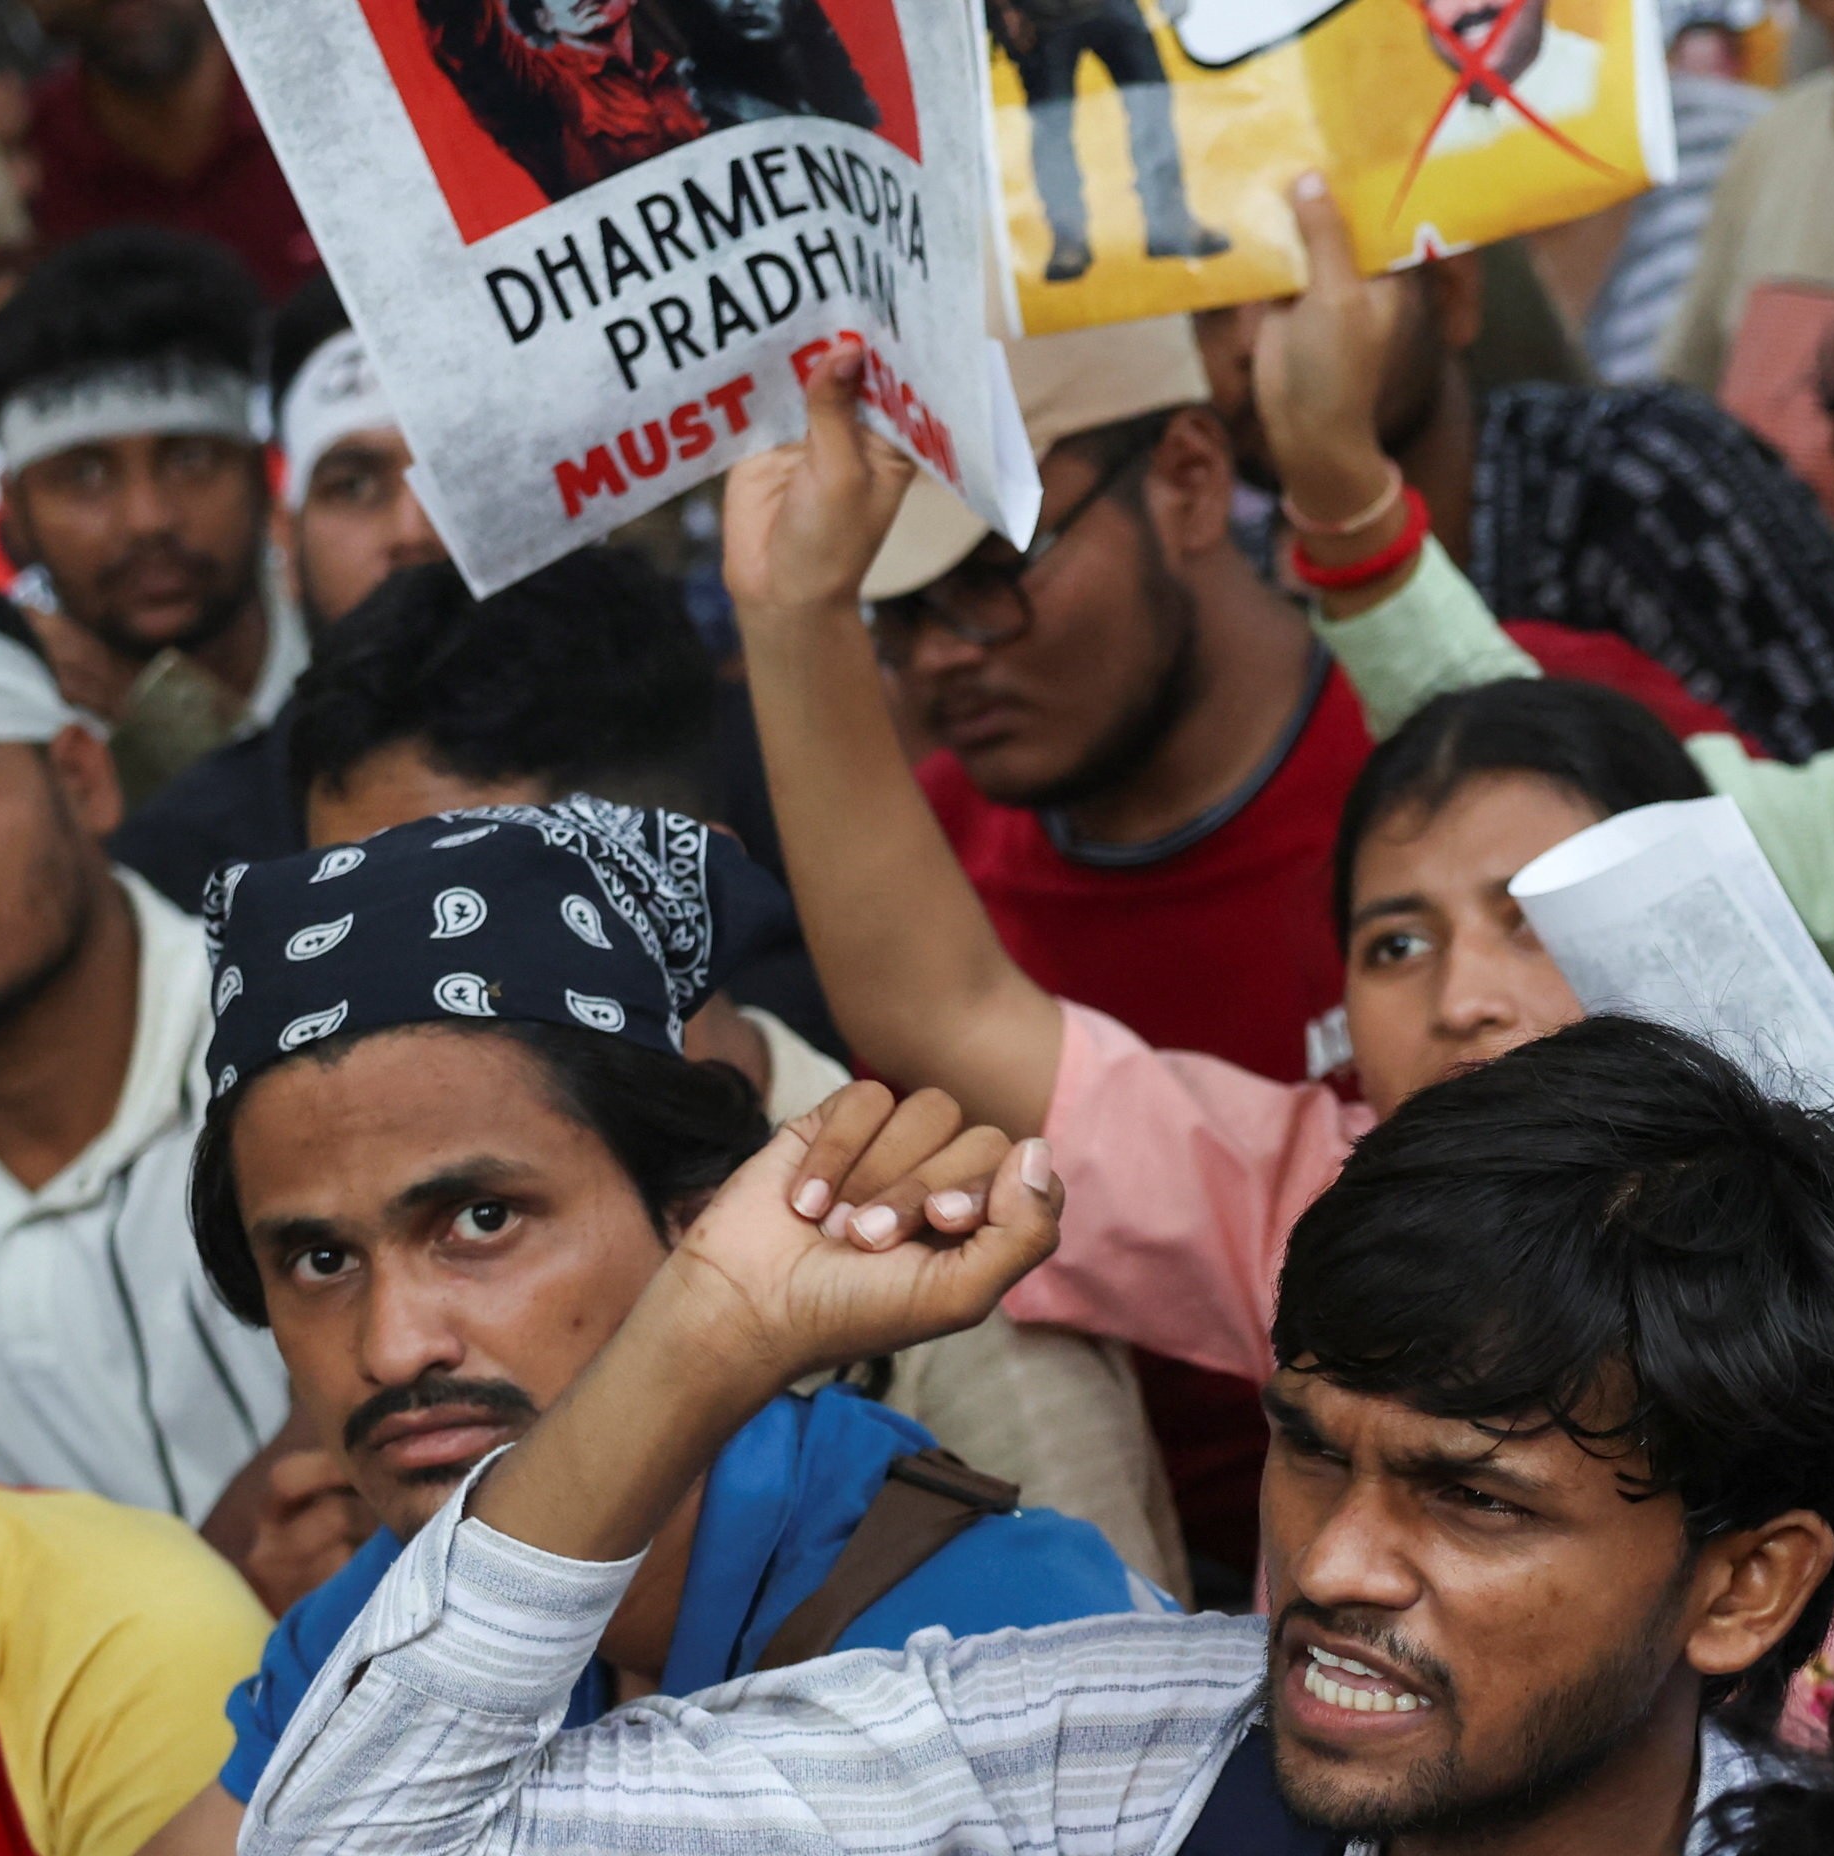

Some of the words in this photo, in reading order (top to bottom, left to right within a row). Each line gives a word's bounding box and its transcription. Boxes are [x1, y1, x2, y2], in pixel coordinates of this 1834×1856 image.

[485, 143, 928, 345] DHARMENDRA
[603, 227, 901, 391] PRADHAN
[552, 373, 756, 519] MUST
